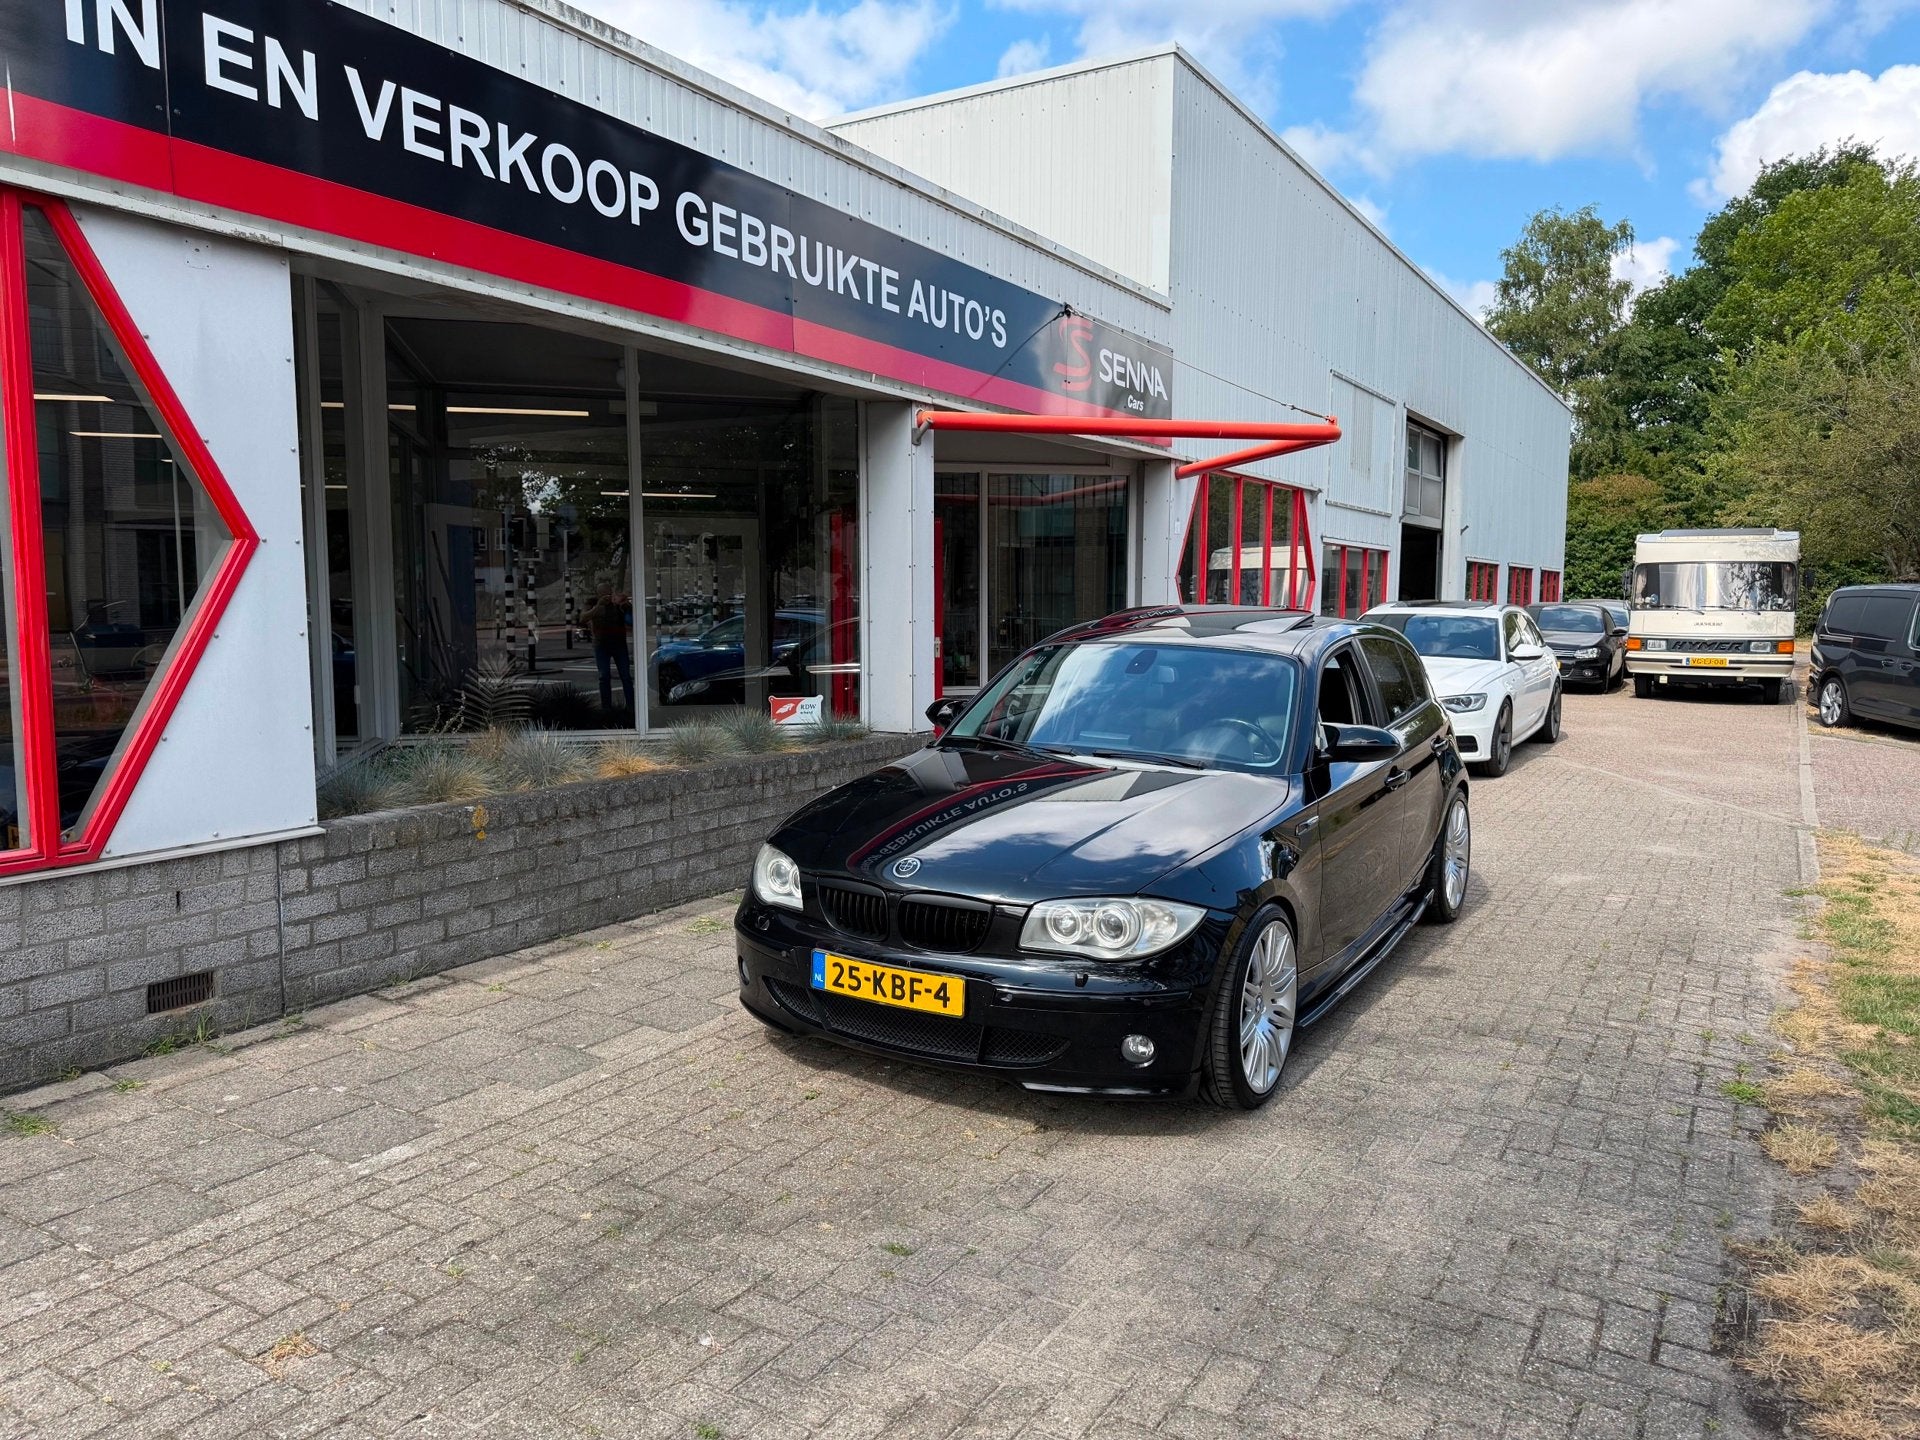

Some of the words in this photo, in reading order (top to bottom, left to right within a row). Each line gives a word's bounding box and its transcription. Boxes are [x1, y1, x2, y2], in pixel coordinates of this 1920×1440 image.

[65, 0, 160, 70] IN
[202, 12, 319, 121] EN
[344, 64, 660, 226] VERKOOP
[675, 191, 899, 313] GEBRUIKTE
[907, 280, 1006, 349] AUTO'S
[1099, 348, 1168, 401] SENNA
[1127, 394, 1144, 411] Cars
[1671, 641, 1743, 651] HYMER
[814, 974, 823, 982] NL
[832, 962, 950, 1008] 25-KBF-4
